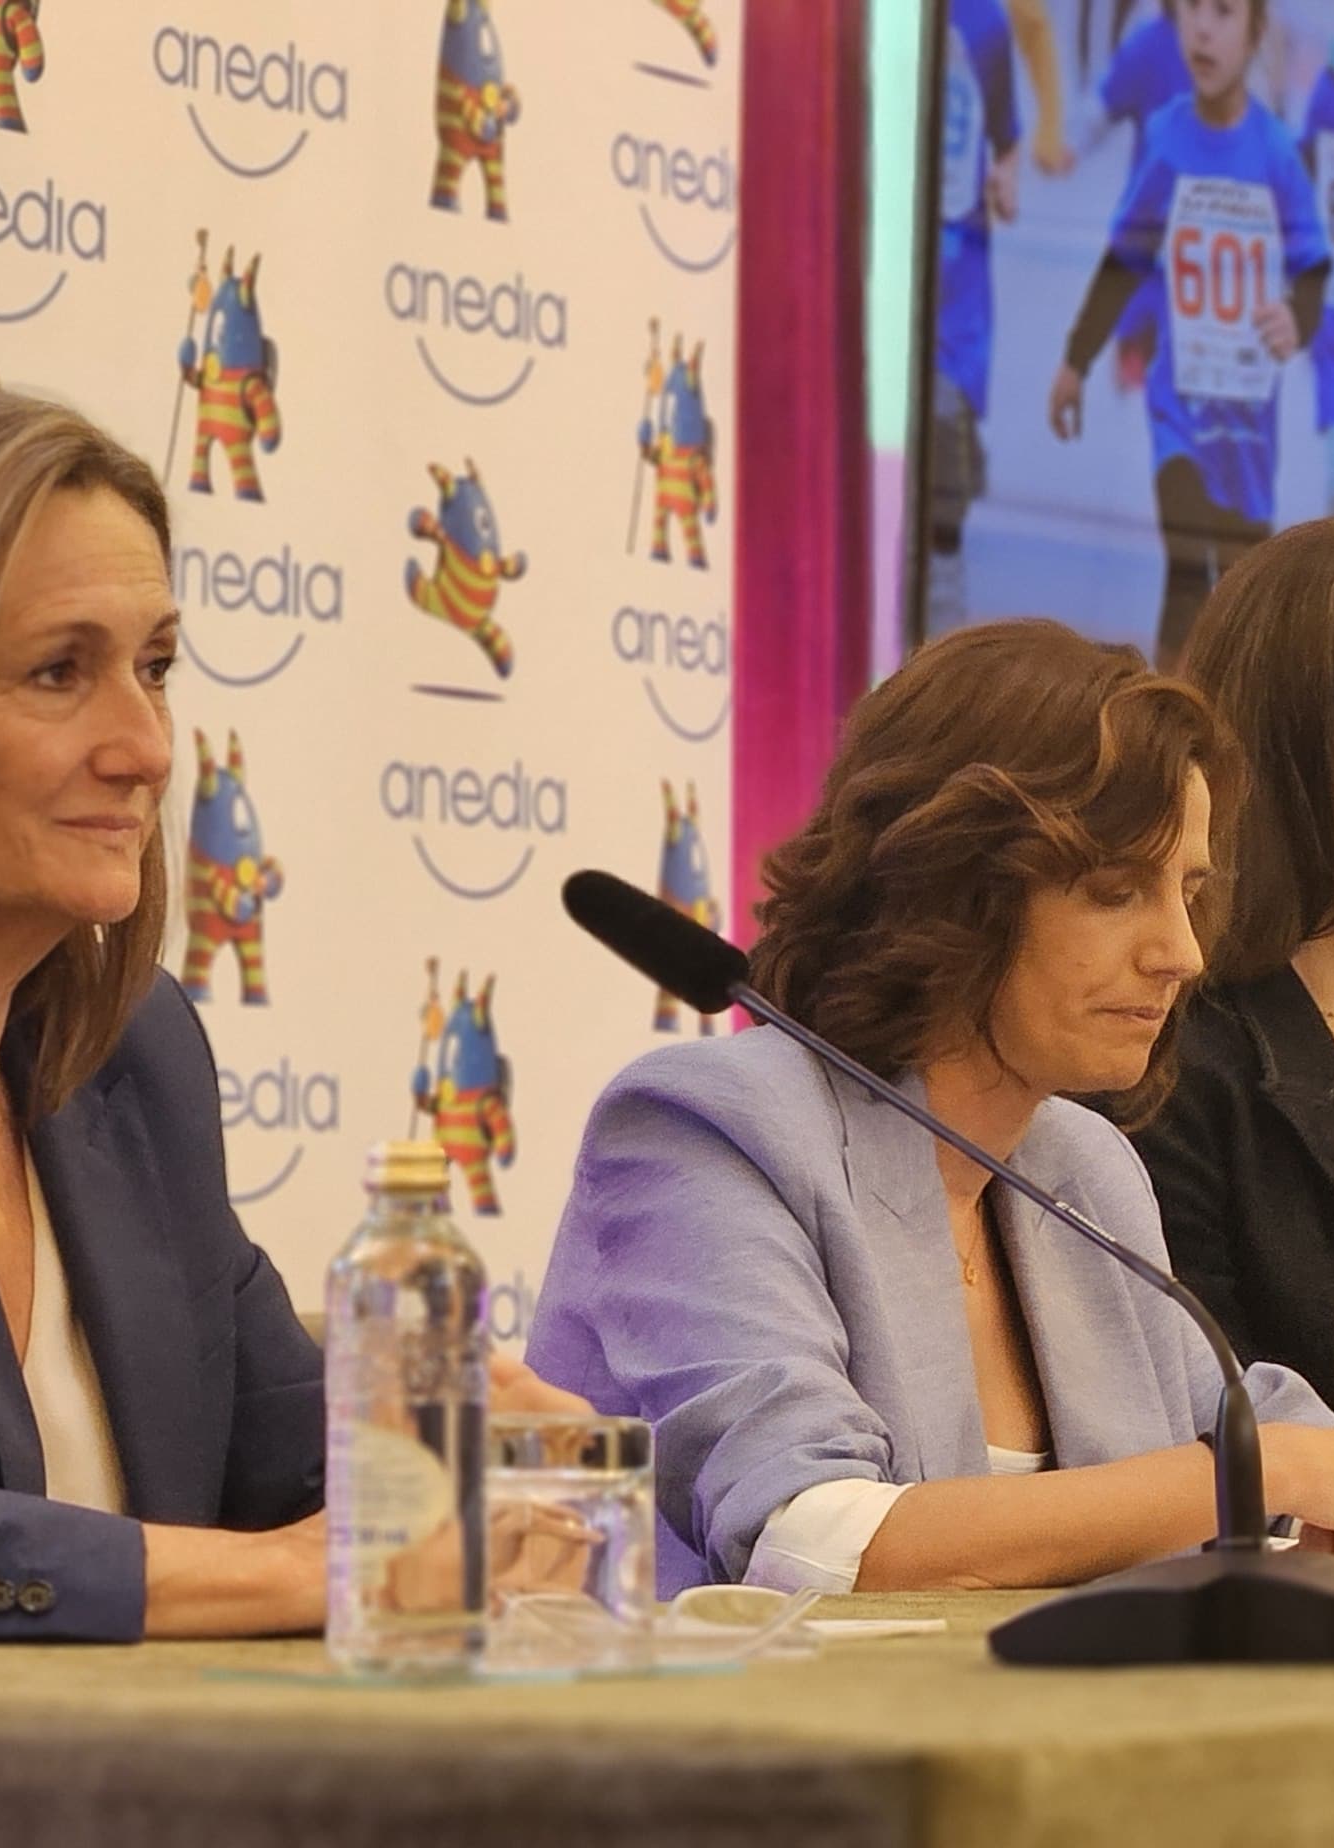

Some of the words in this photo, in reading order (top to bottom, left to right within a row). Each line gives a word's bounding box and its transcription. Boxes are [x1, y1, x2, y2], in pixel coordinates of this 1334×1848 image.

[153, 26, 348, 122] anedia
[384, 262, 567, 349] anedia
[1173, 226, 1266, 325] 601
[172, 542, 343, 623] nedia
[379, 759, 567, 834] anedia
[216, 1055, 340, 1133] edia
